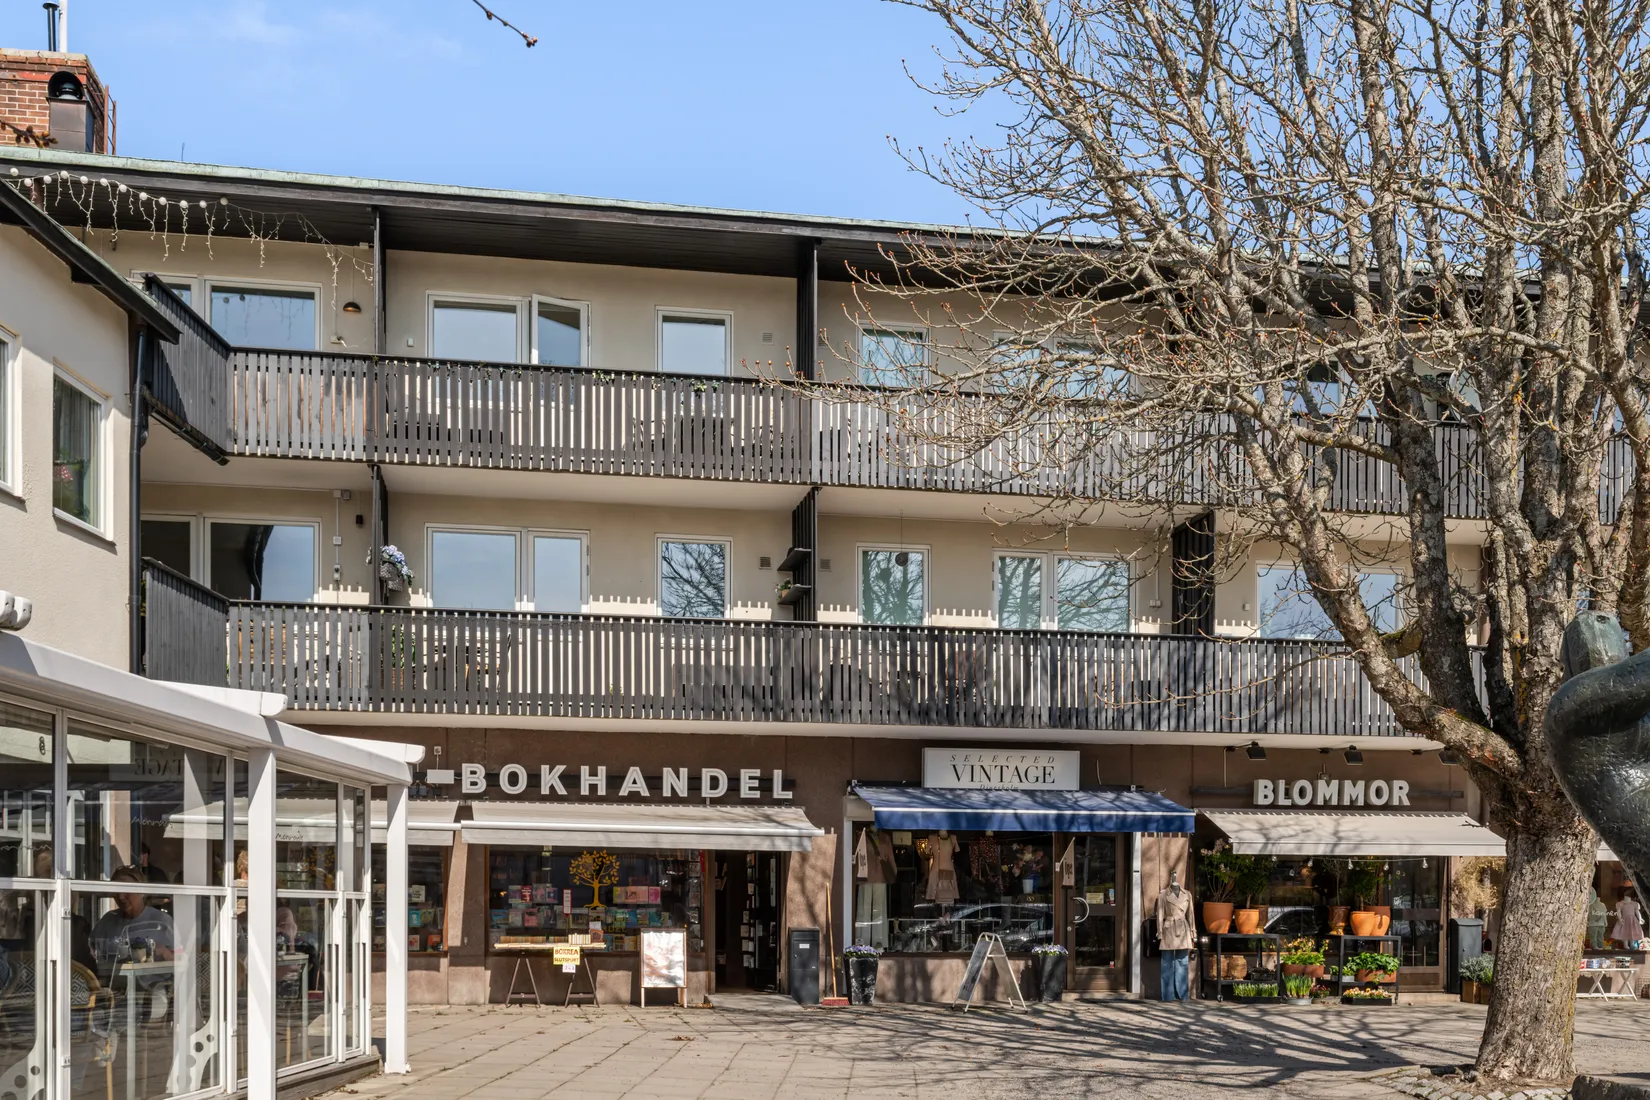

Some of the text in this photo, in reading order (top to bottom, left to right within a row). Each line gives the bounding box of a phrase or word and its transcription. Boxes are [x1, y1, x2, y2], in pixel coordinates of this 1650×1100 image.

[950, 754, 1055, 764] SELECTED
[461, 763, 793, 799] BOKHANDEL
[950, 764, 1056, 784] VINTAGE
[1253, 778, 1411, 807] BLOMMOR
